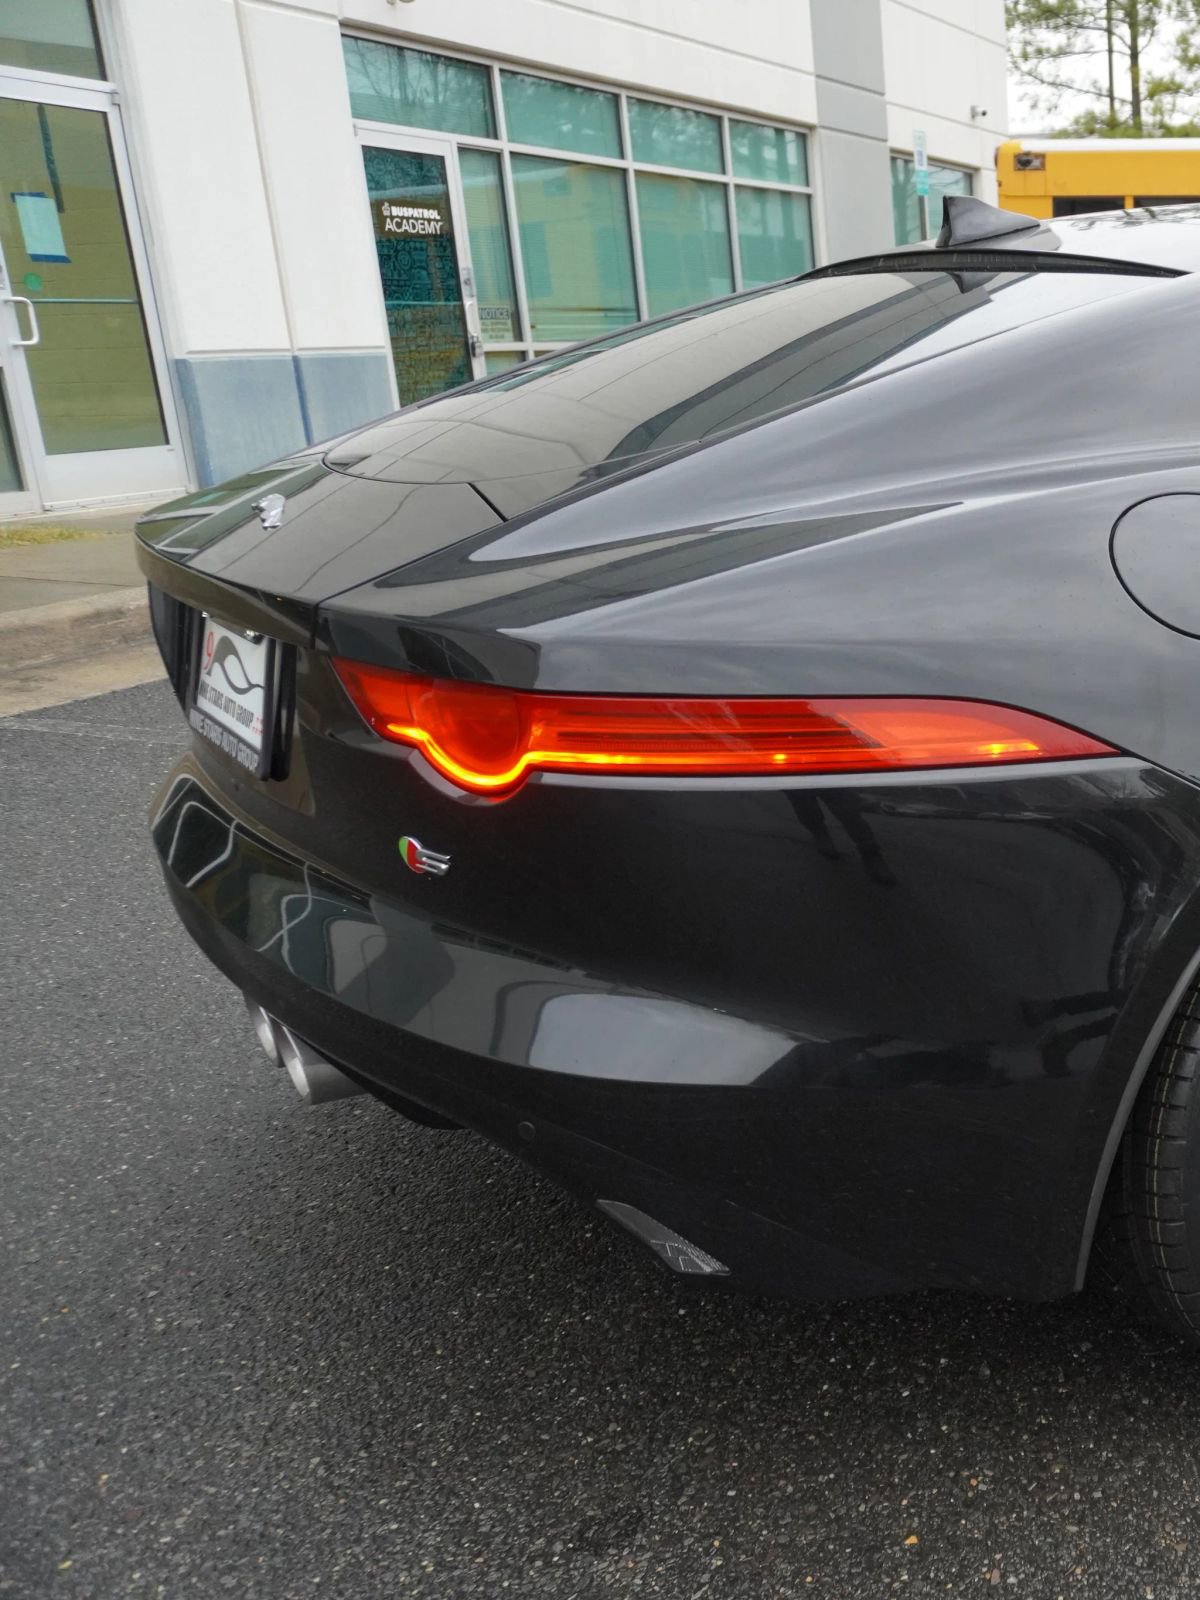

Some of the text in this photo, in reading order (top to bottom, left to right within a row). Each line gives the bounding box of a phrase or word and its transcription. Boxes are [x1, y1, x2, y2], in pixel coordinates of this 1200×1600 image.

[385, 217, 442, 235] ACADEMY
[391, 205, 441, 220] BUSPATROL
[208, 686, 224, 710] STARS
[223, 695, 237, 719] AUTO
[236, 704, 255, 729] GROUP
[203, 718, 223, 746] STARS
[221, 731, 239, 758] AUTO
[237, 742, 259, 774] GROUP
